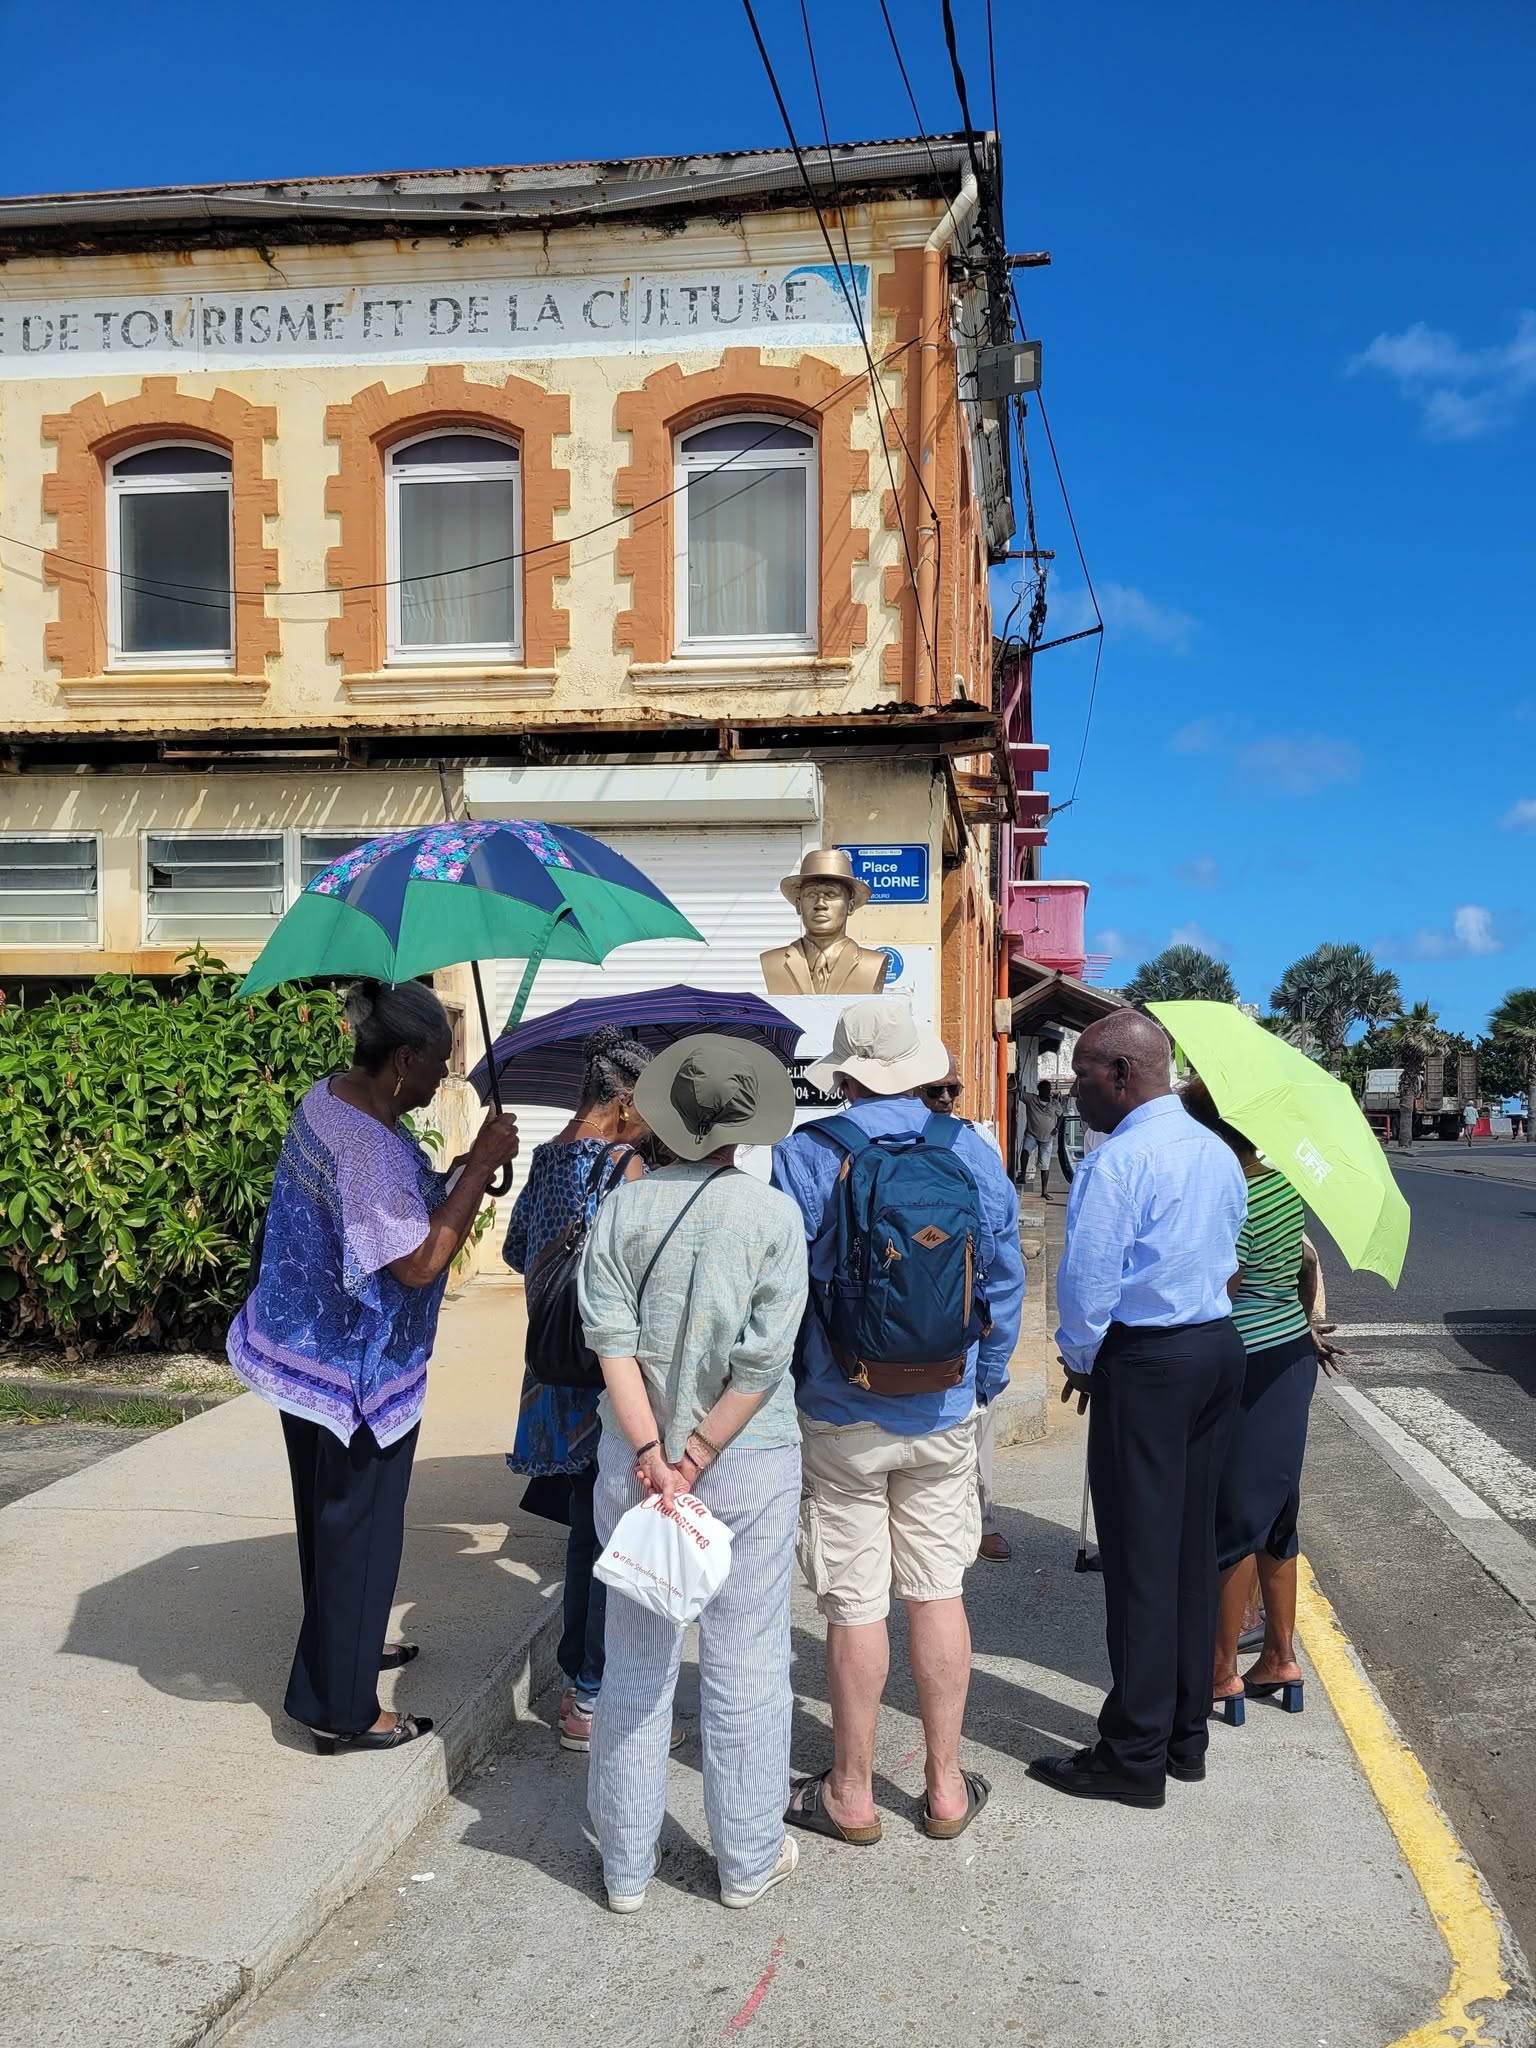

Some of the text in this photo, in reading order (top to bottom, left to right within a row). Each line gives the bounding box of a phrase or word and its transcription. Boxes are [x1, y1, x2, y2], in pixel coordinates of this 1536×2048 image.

[22, 314, 79, 352] DE
[94, 303, 344, 349] TOURISME
[363, 299, 412, 339] ET
[429, 296, 489, 336] DE
[508, 293, 565, 332] LA
[582, 280, 807, 329] CULTURE
[862, 861, 898, 873] Place
[873, 876, 920, 888] LORNE
